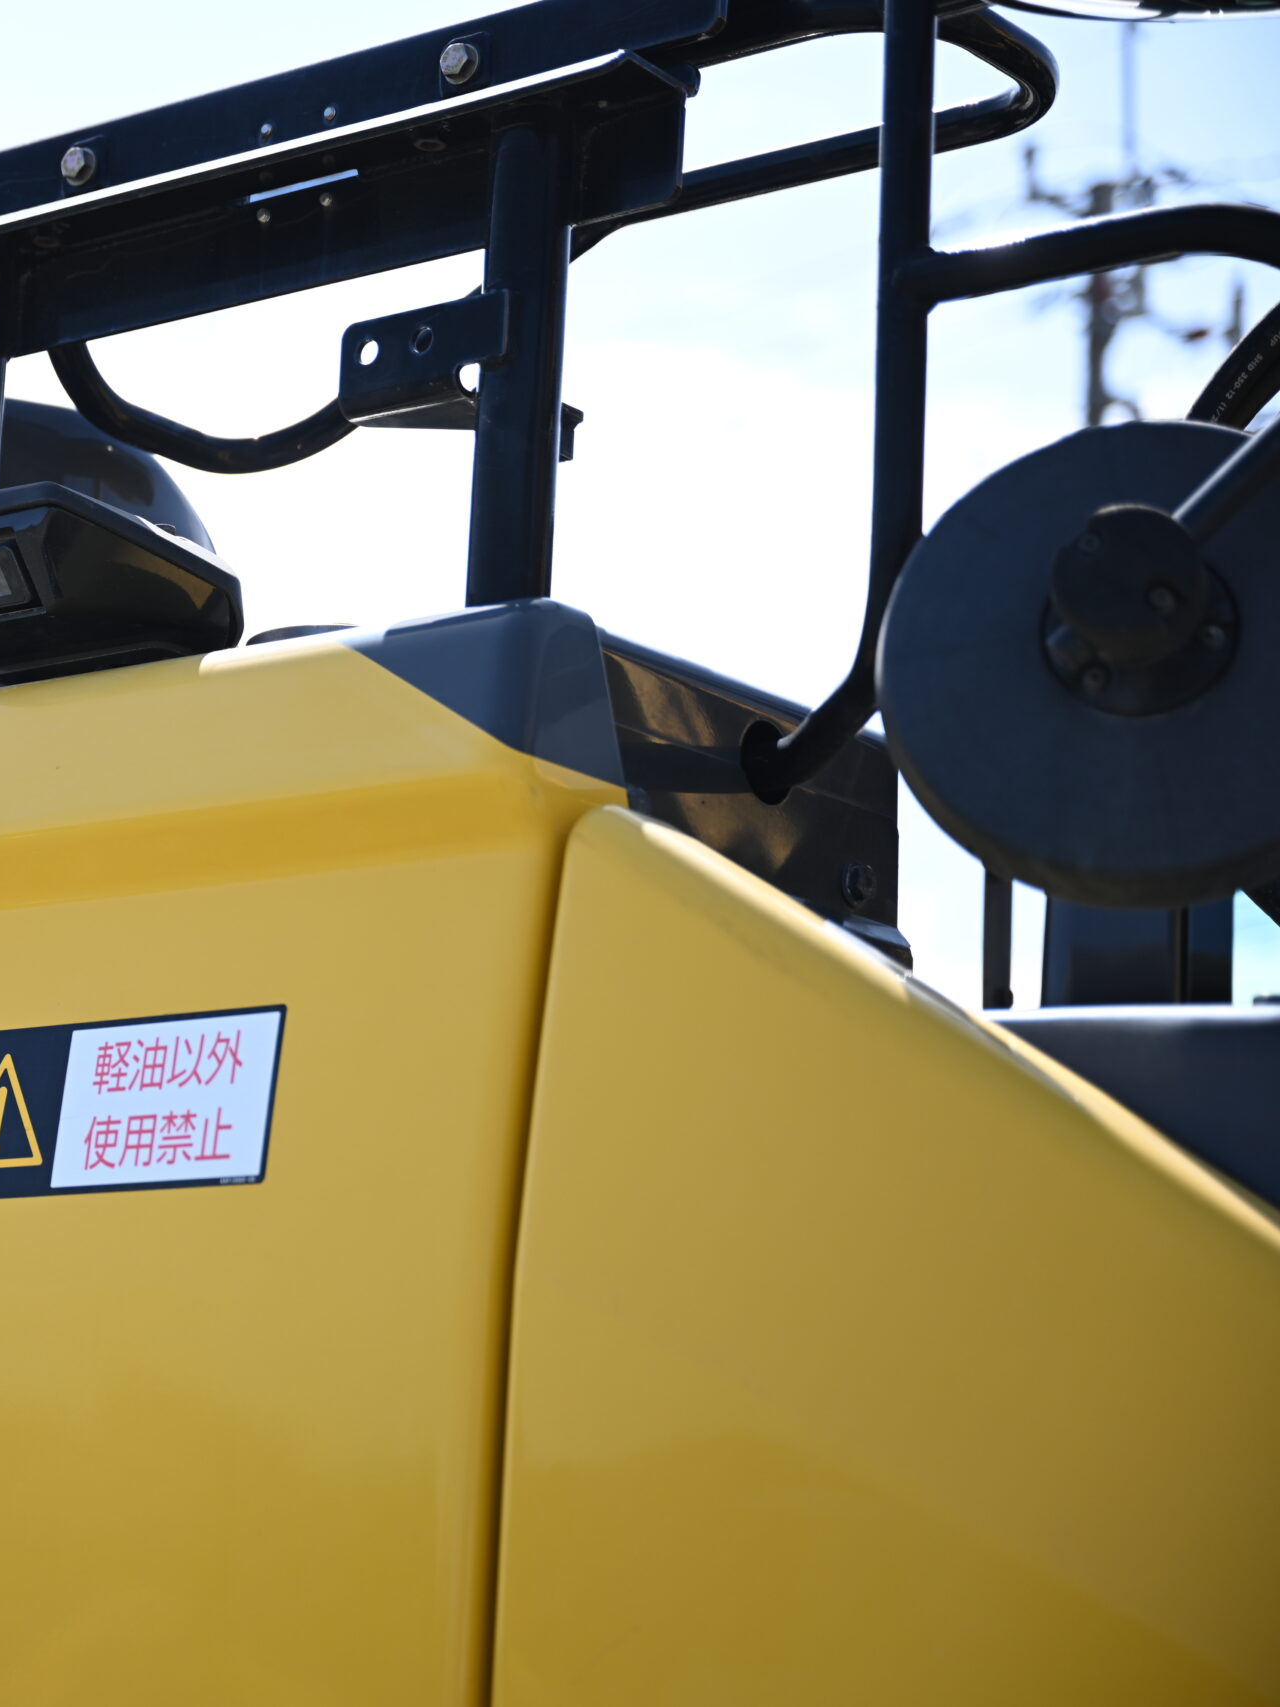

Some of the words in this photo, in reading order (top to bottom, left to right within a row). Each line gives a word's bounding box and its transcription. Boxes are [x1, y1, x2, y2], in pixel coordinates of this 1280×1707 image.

[92, 1029, 243, 1095] 軽油以外
[84, 1106, 233, 1171] 使用禁止
